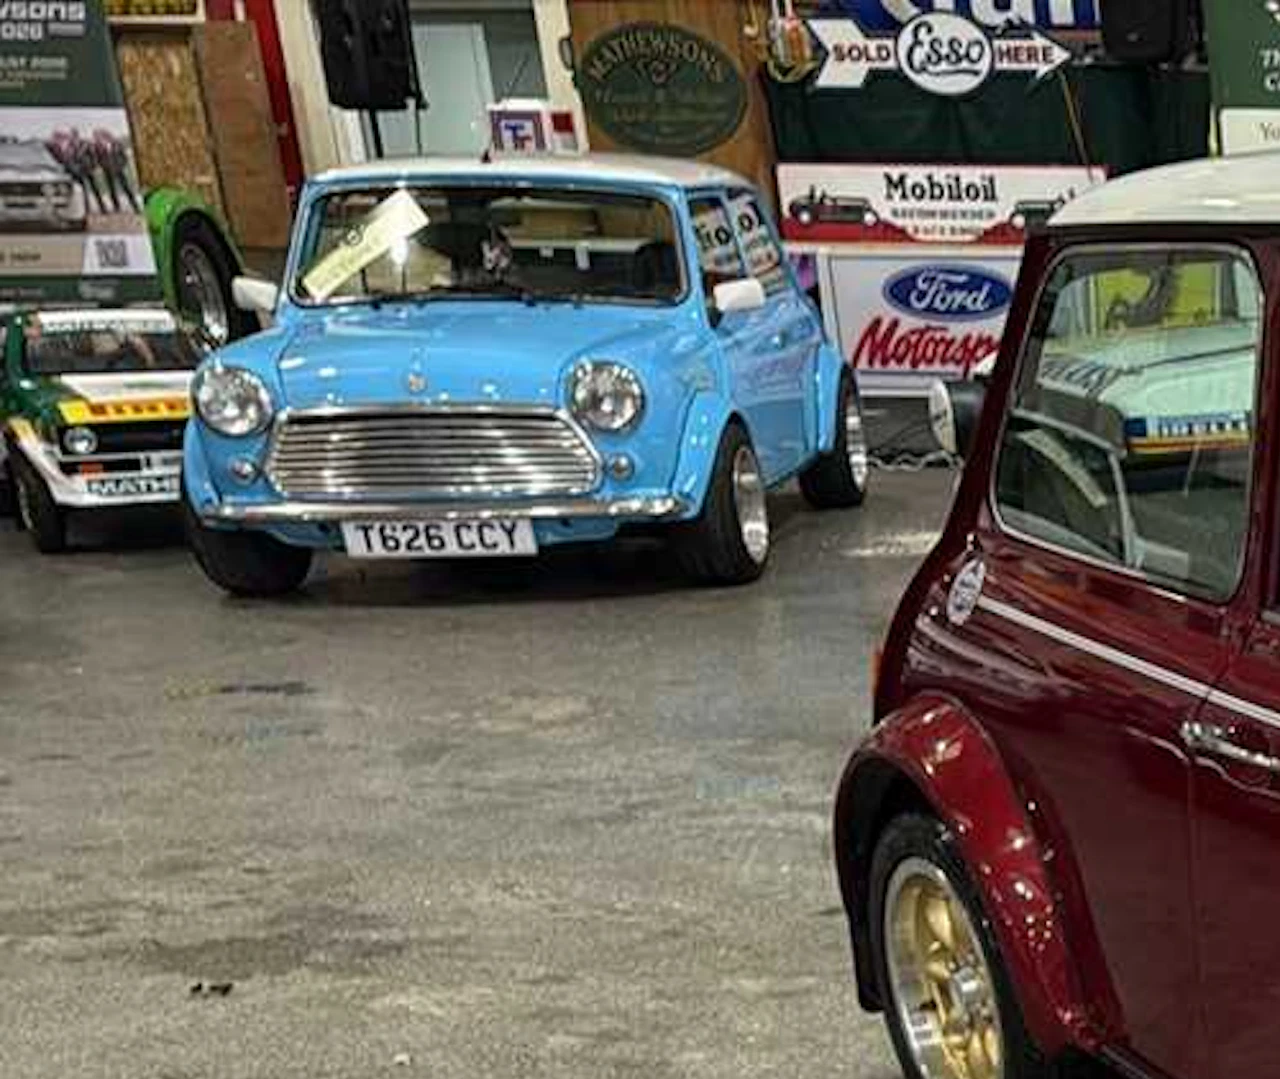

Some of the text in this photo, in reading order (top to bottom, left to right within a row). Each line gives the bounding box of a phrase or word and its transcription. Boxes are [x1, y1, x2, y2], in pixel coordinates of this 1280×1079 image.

[832, 20, 1053, 77] SOLD Esso HERE
[884, 172, 998, 201] Mobiloil
[909, 268, 990, 311] Ford
[355, 523, 516, 552] T626 CCY
